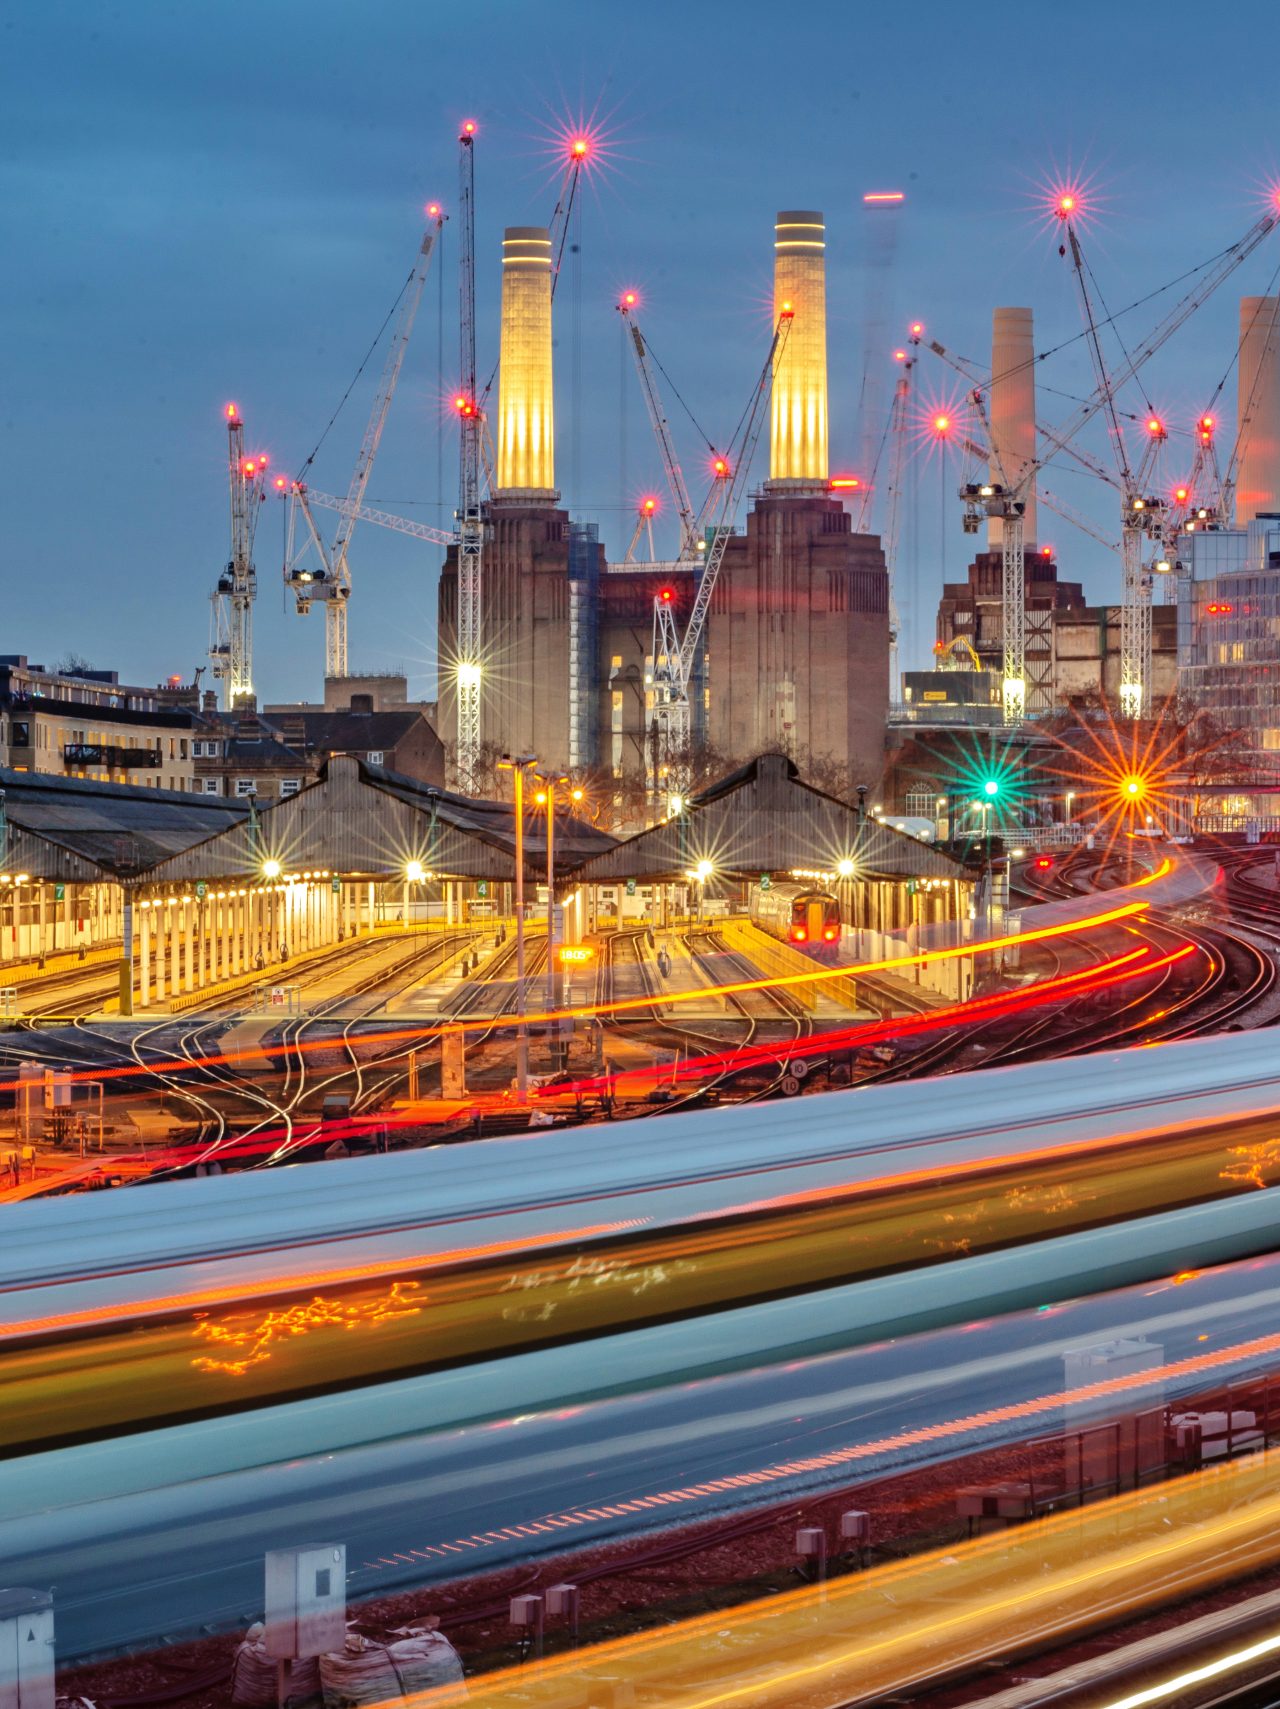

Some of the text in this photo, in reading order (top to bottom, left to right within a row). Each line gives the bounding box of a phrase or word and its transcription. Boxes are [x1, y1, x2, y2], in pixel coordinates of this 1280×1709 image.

[332, 879, 340, 891] 5
[627, 881, 635, 894] 3
[760, 876, 769, 889] 2
[908, 881, 915, 893] 1
[55, 886, 65, 898] 7
[196, 884, 206, 896] 6
[478, 884, 487, 895] 4
[794, 1064, 804, 1074] 10
[785, 1081, 797, 1091] 10
